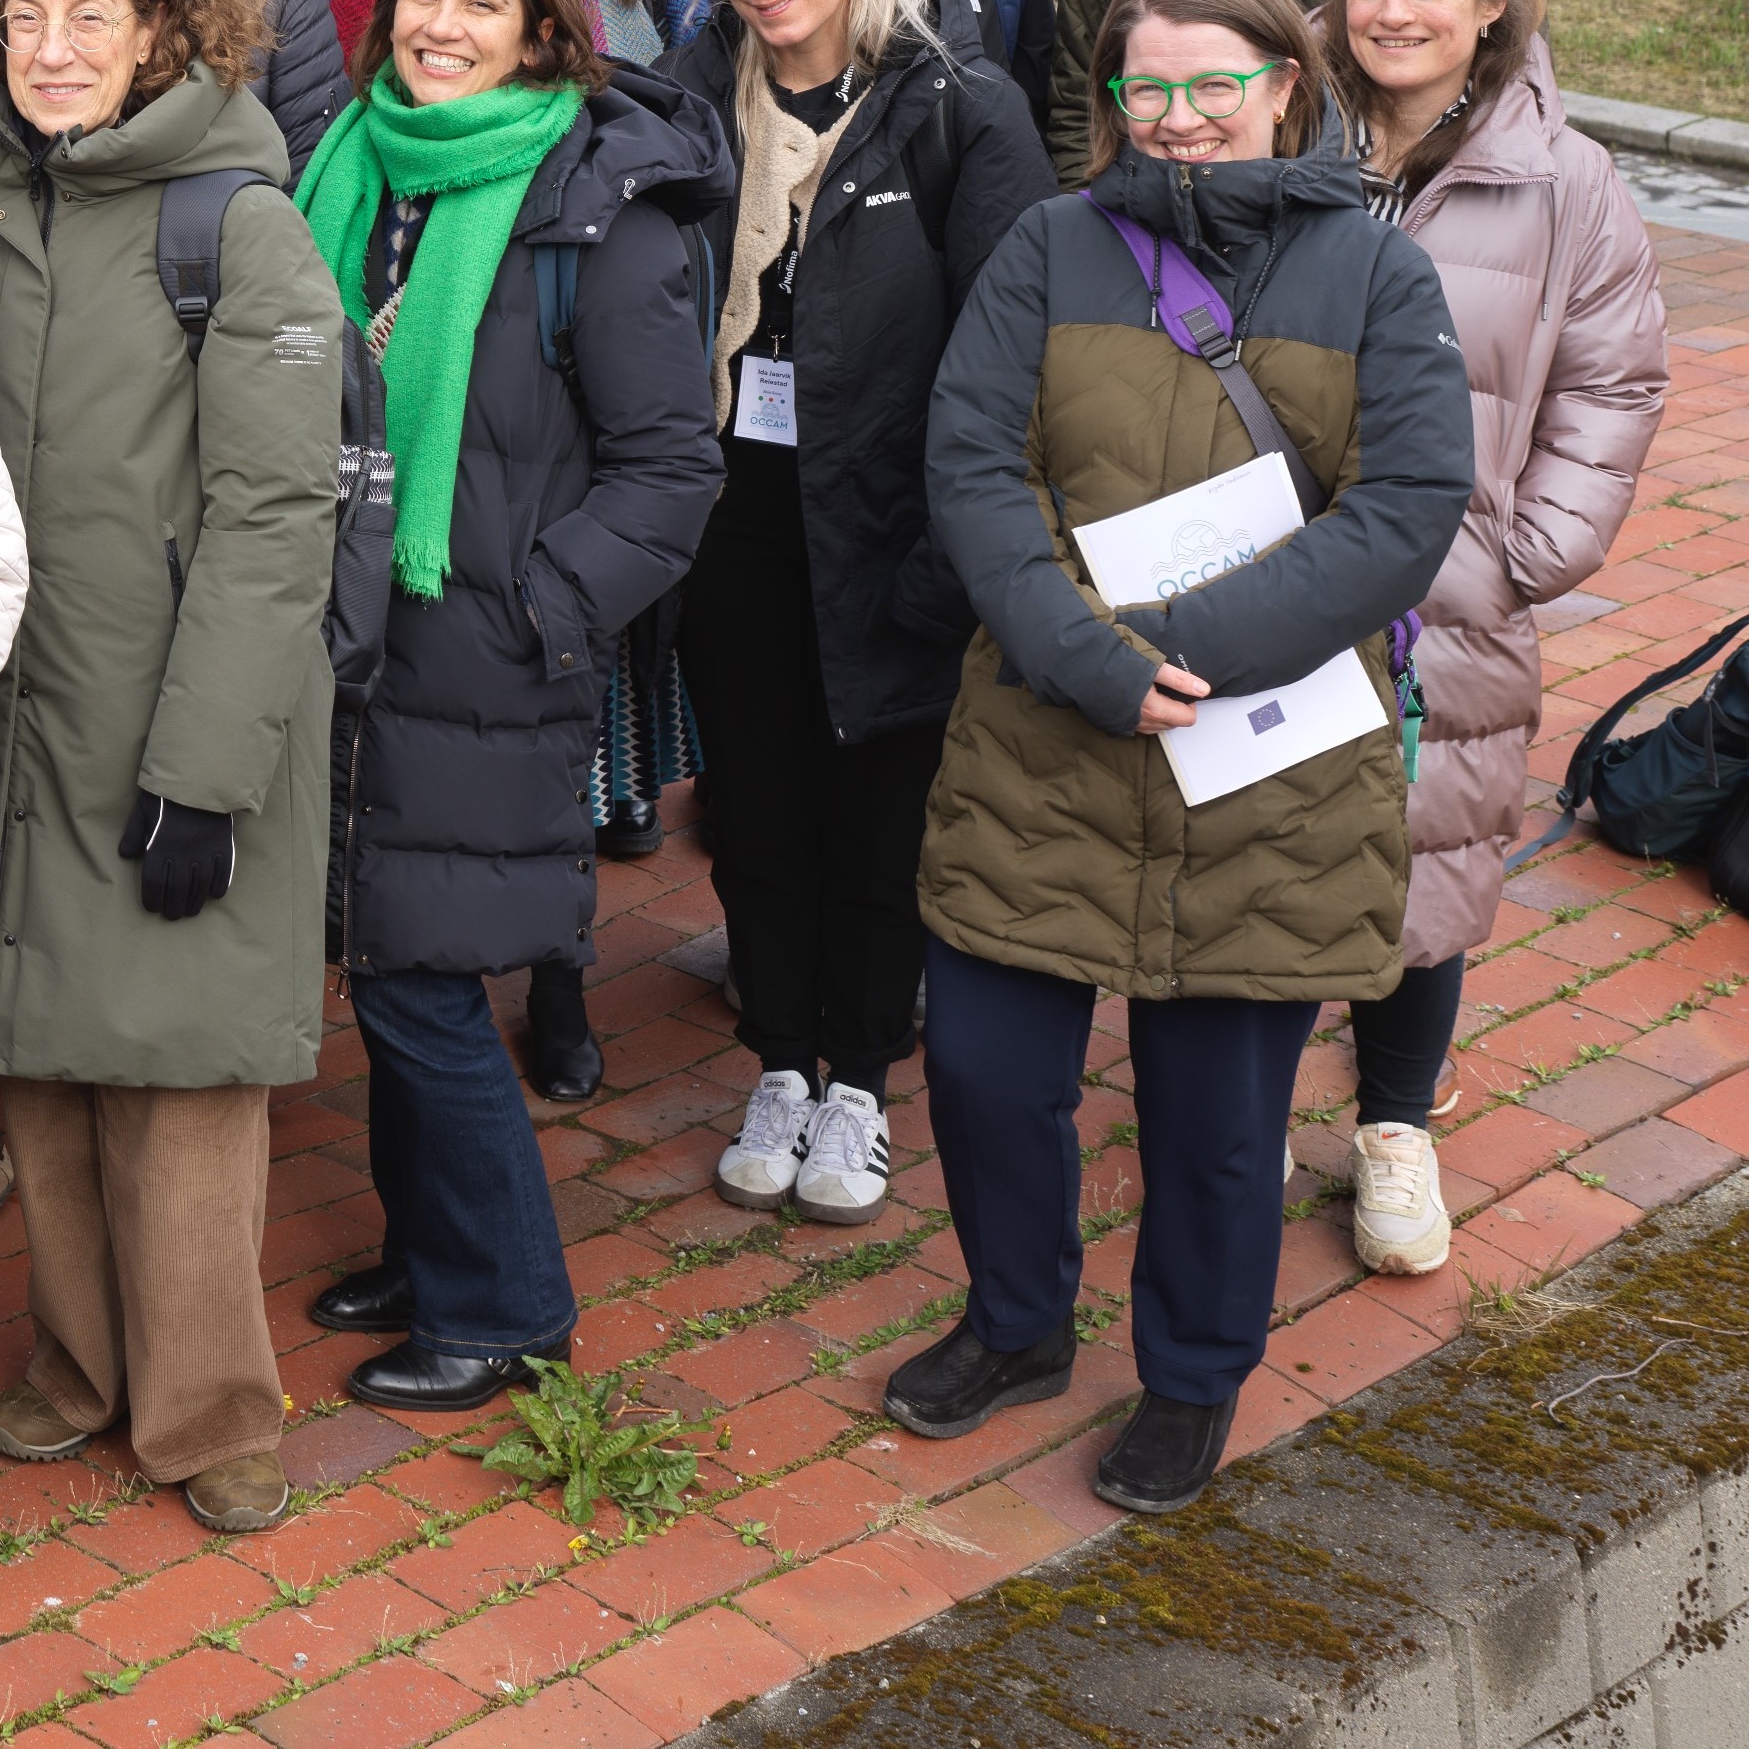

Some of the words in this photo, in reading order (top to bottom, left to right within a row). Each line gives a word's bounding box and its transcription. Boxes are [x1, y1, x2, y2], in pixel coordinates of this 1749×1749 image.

[840, 61, 855, 93] Nofim
[783, 250, 798, 285] Nofima
[757, 368, 768, 376] Ida
[769, 370, 792, 380] Jaarvik
[750, 416, 788, 430] OCCAM
[763, 1079, 786, 1088] adidas
[839, 1093, 867, 1108] adidas
